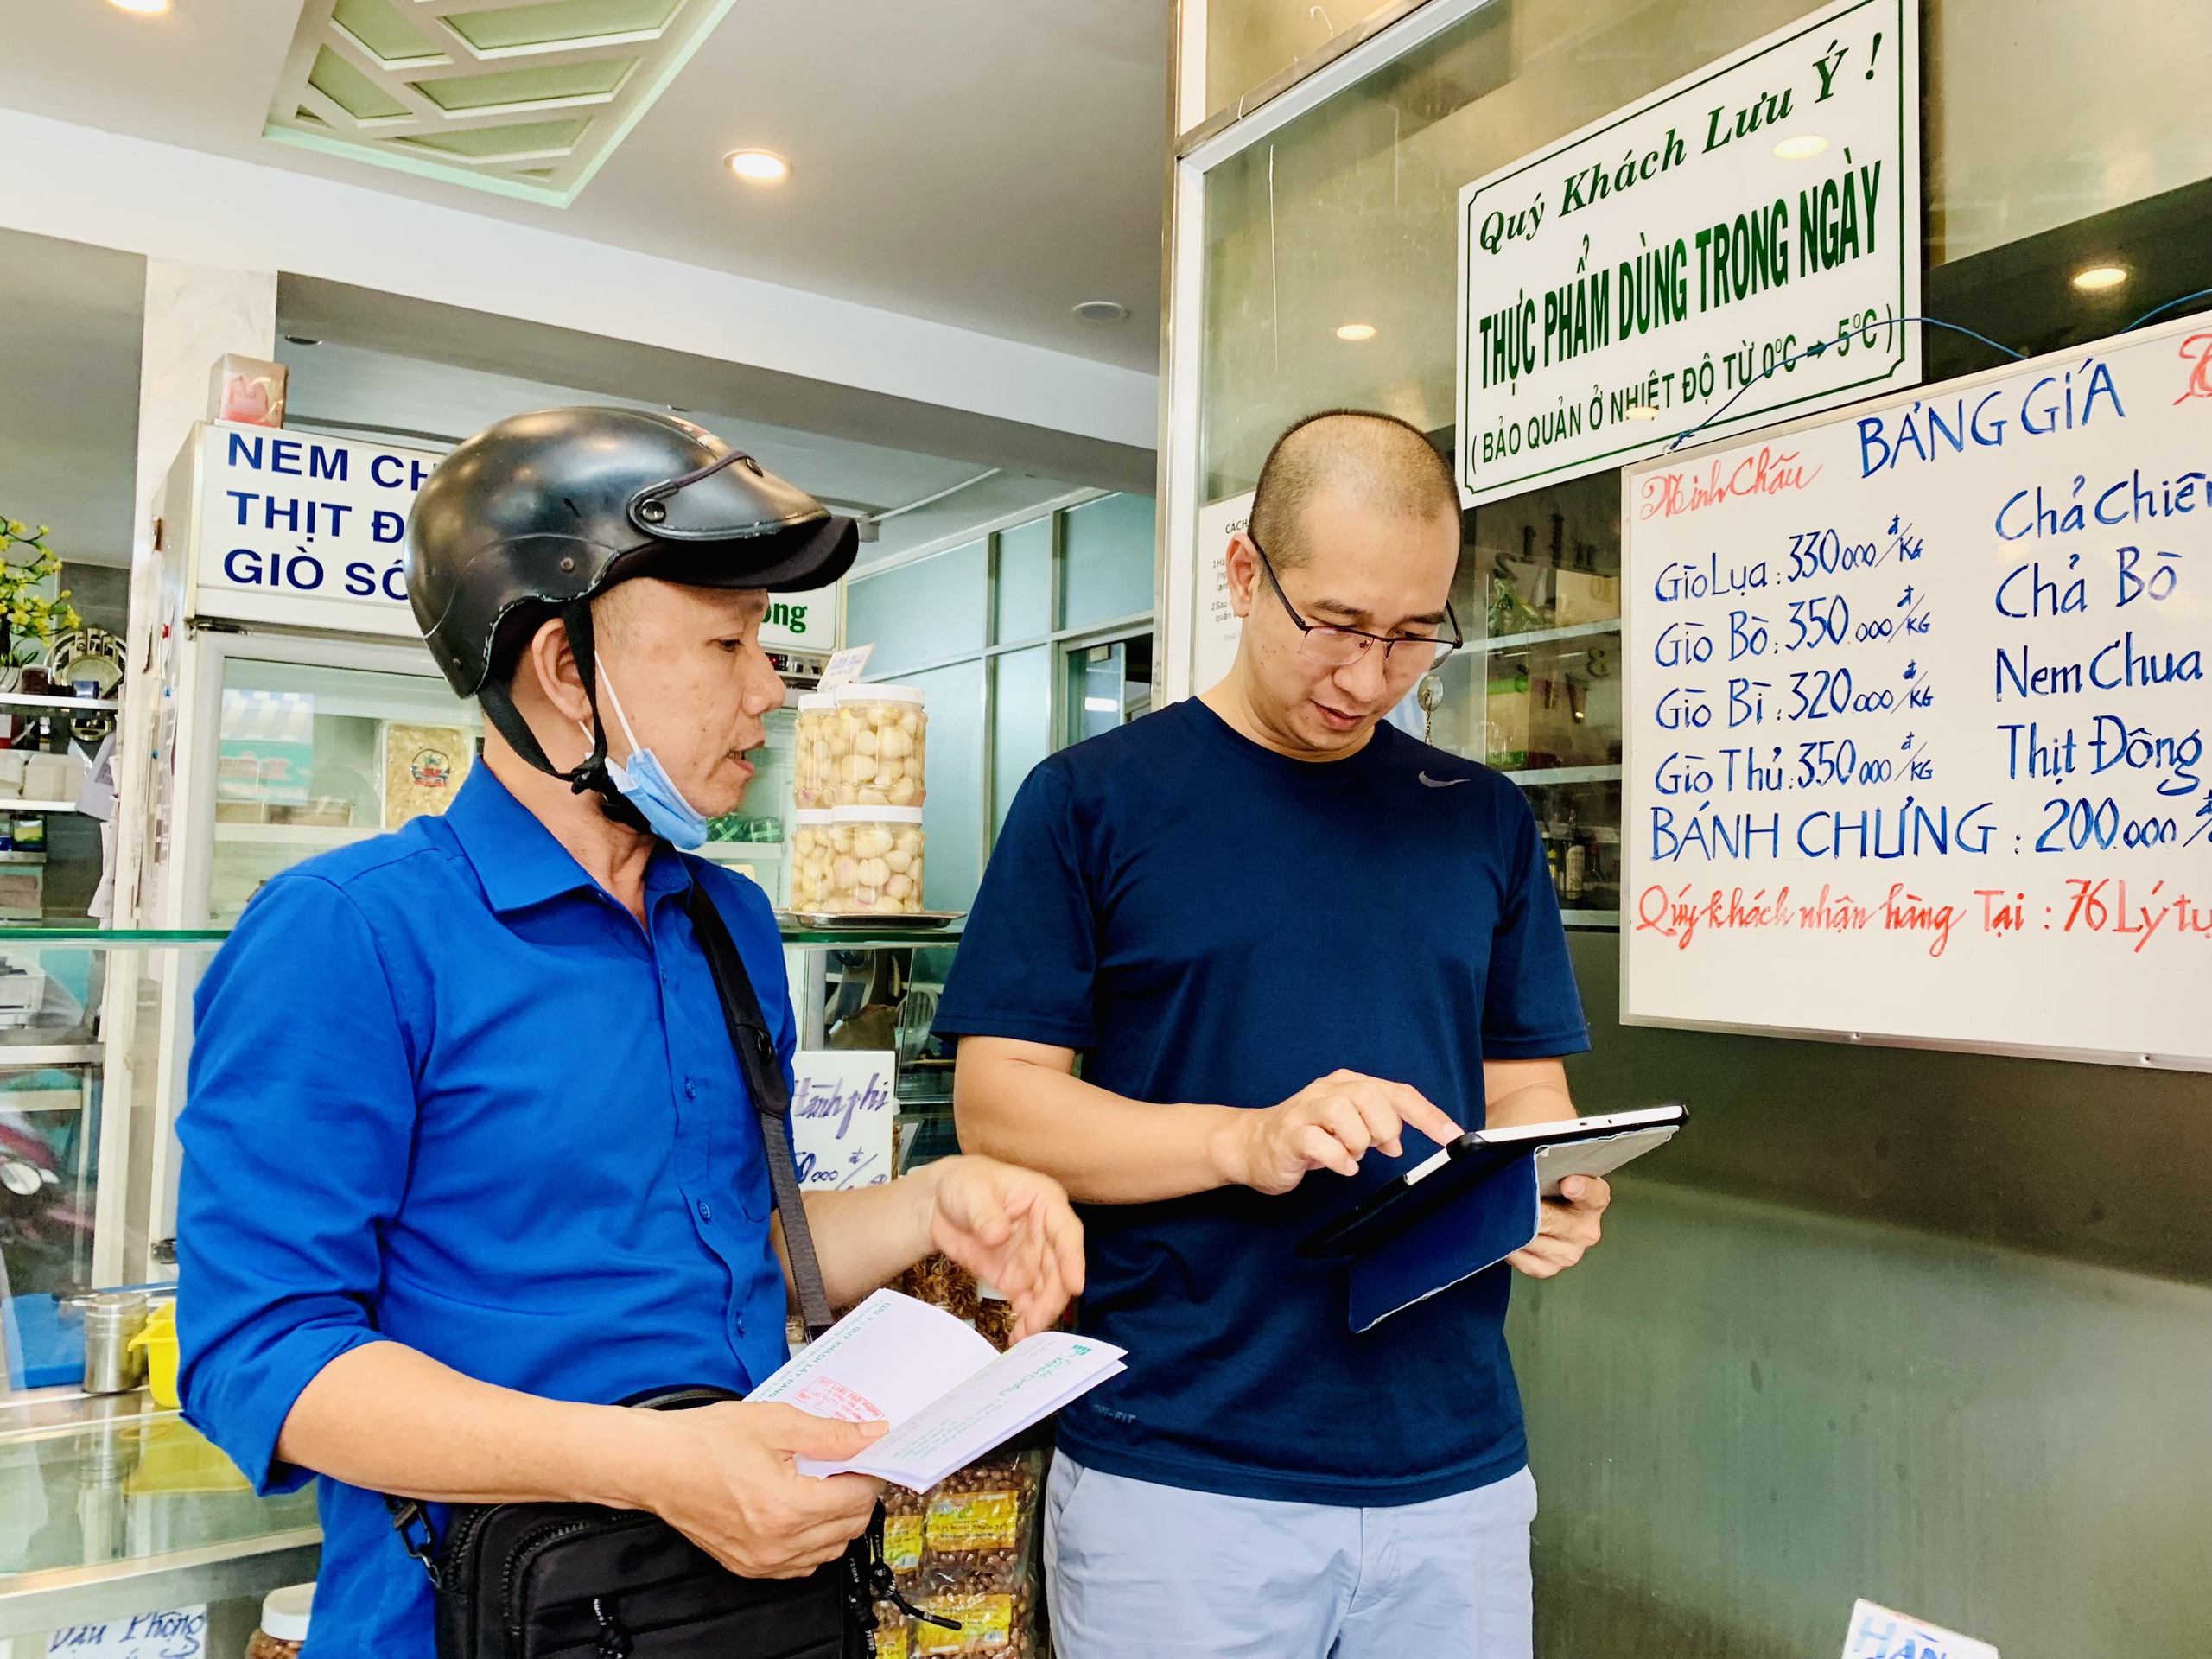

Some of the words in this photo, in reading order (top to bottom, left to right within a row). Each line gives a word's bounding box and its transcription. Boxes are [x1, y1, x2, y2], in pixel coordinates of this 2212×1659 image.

[1479, 193, 1545, 254] Quý
[1559, 129, 1687, 217] Khách
[1702, 88, 1794, 153] Lưu
[1813, 39, 1849, 104] Ý
[1479, 288, 1535, 396] THỰC
[1544, 234, 1610, 368] PHẨM
[1619, 232, 1687, 341] DÙNG
[1695, 199, 1789, 313] TRONG
[1800, 148, 1882, 278] NGÀY
[1528, 396, 1581, 450] QUẢN
[1589, 385, 1604, 430] Ở
[1611, 370, 1675, 424] NHIỆT
[1682, 352, 1714, 405] ĐỘ
[1723, 340, 1755, 390] TỪ
[227, 433, 348, 482] NEM
[1857, 401, 2007, 479] BẢNG
[226, 490, 352, 543] THỊT
[1995, 475, 2086, 541] Chả
[224, 546, 324, 590] GIÒ
[1995, 554, 2088, 618] Chả
[2116, 546, 2183, 607] Bò
[1996, 645, 2083, 702] Nem
[2089, 631, 2203, 690] Chua
[1996, 721, 2077, 785] Thịt
[2088, 715, 2202, 796] Đông
[1649, 800, 1779, 862] BÁNH
[1796, 795, 1998, 859] CHƯNG
[1799, 884, 1877, 933] nhận
[1974, 890, 2024, 938] Tại
[2063, 878, 2110, 932] 76
[2112, 880, 2170, 953] Lý
